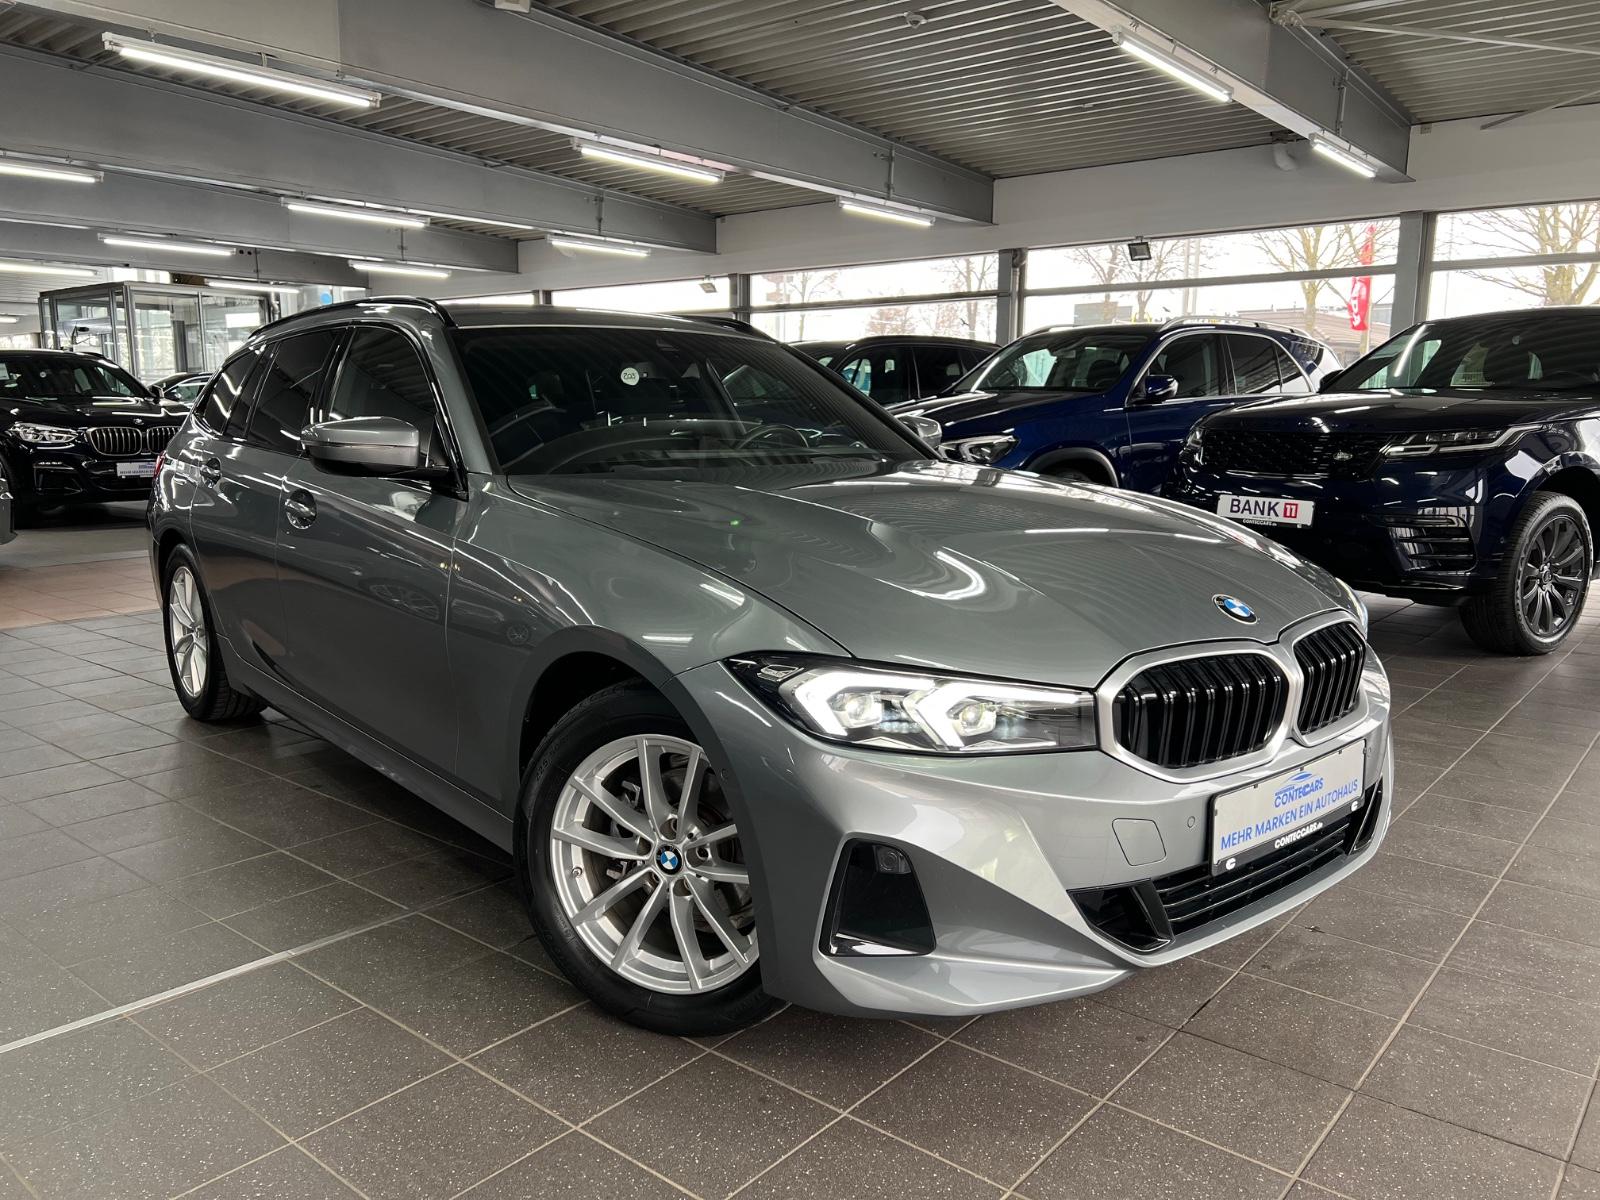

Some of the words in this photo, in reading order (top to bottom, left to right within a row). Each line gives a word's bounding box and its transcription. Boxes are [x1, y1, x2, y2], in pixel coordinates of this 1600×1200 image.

[1230, 498, 1280, 517] BANK
[1220, 826, 1252, 851] MEHR
[1255, 810, 1297, 838] MARKEN
[1299, 805, 1313, 819] EIN
[1314, 778, 1358, 813] AUTOHAUS
[1274, 821, 1324, 849] CONTECCARS.de
